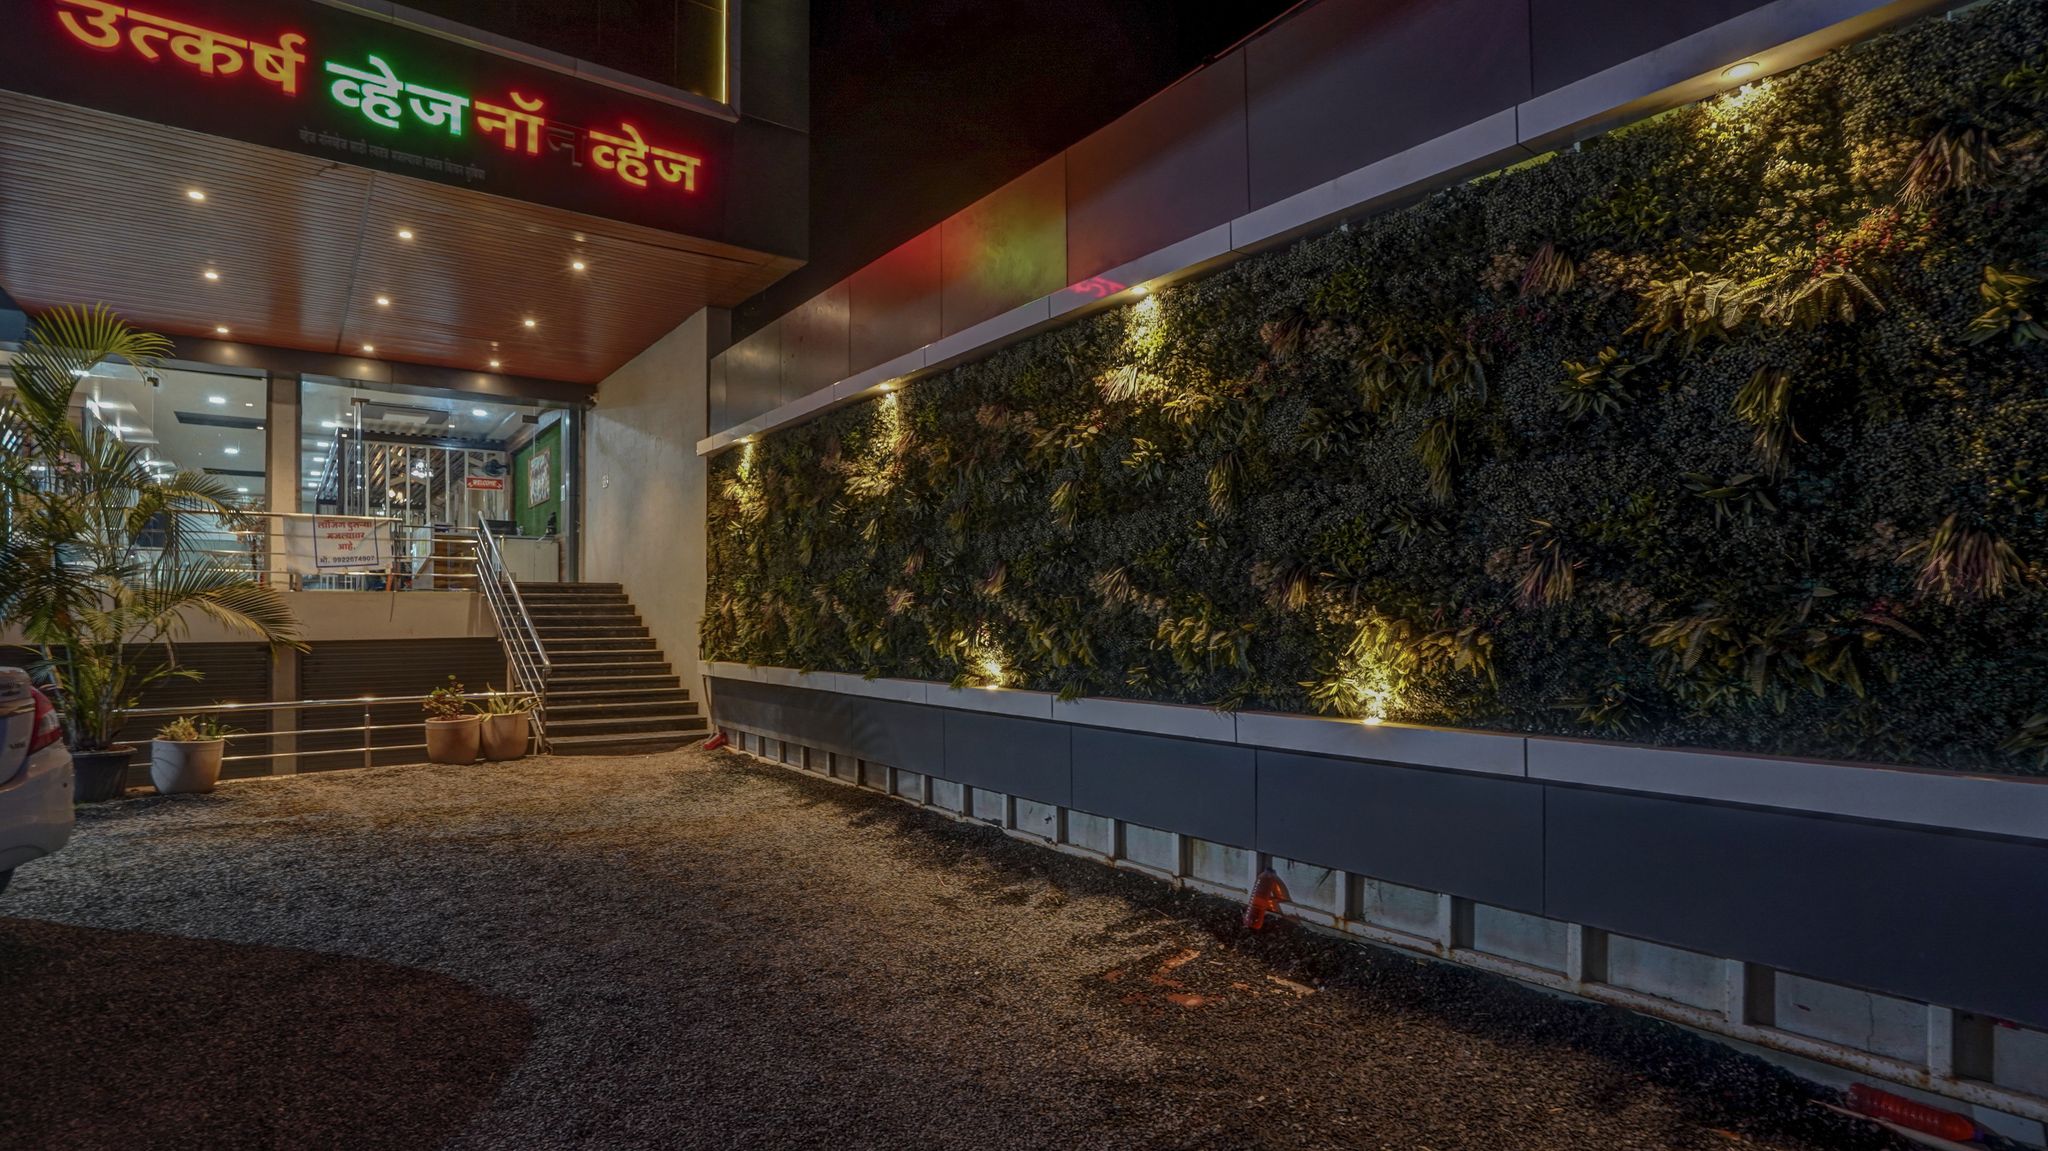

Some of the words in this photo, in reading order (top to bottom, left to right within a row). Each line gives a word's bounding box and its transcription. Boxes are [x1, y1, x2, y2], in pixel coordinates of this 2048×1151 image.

[57, 0, 305, 97] उत्कर्ष
[325, 55, 470, 136] व्हेज
[589, 122, 702, 192] व्हेज
[472, 479, 498, 487] WELCOME
